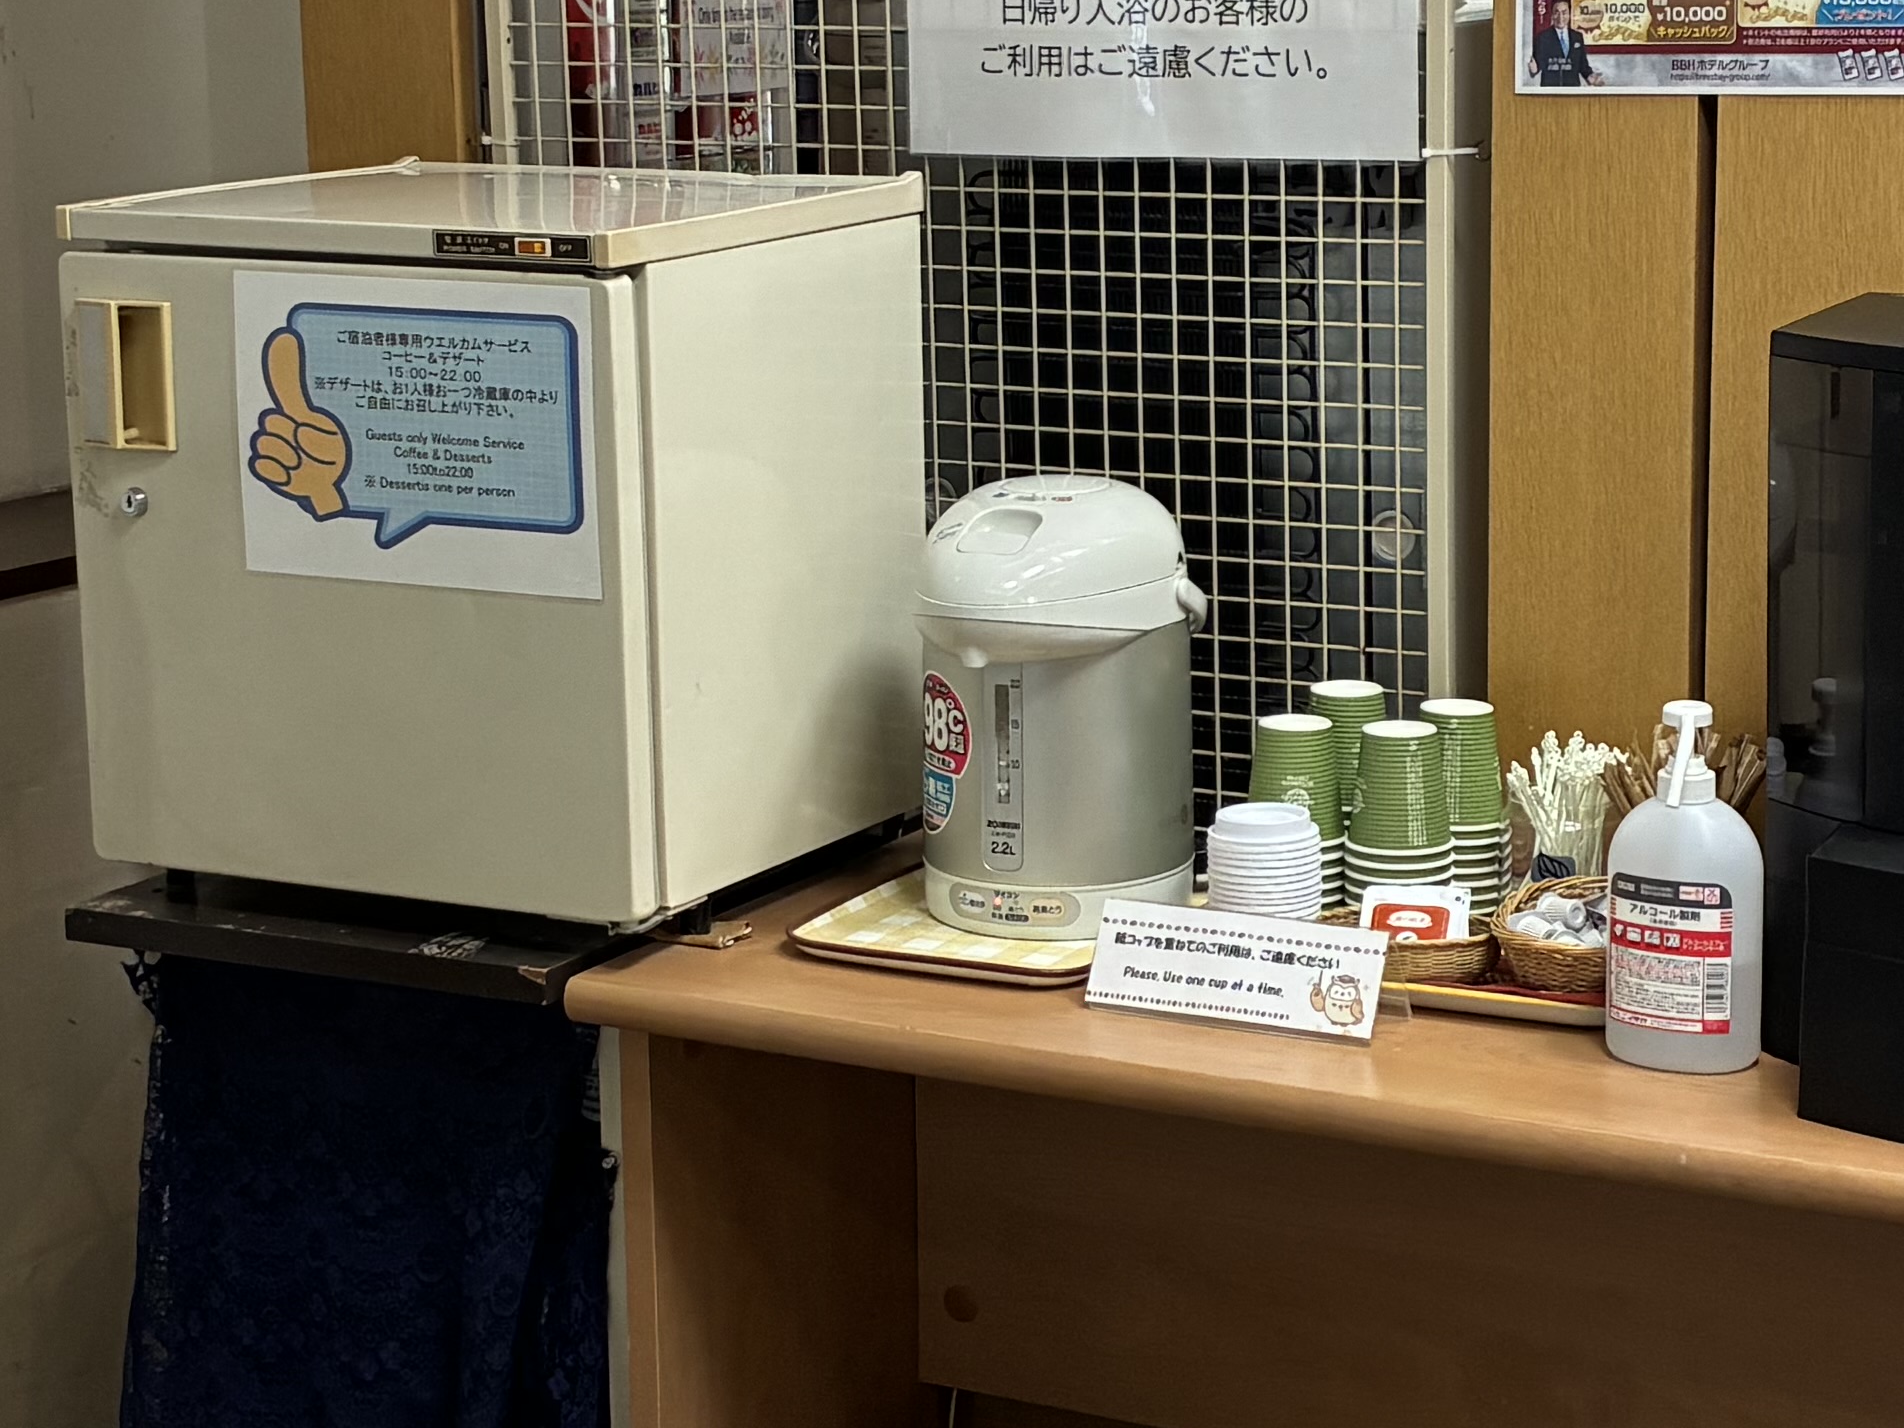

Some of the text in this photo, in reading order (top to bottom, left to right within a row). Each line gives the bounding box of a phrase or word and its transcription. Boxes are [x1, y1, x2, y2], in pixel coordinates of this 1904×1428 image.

[1604, 3, 1645, 14] 10,000
[1657, 26, 1728, 38] キャッシュバック
[981, 44, 1329, 80] ご利用はご遠慮ください。
[366, 428, 525, 450] Guests only Welcome Service
[394, 446, 428, 460] Coffee
[446, 450, 492, 464] Desserts
[433, 483, 453, 493] one
[457, 485, 473, 495] per
[478, 485, 515, 498] person
[1163, 971, 1184, 984] Use
[1186, 976, 1205, 987] one
[1209, 978, 1228, 990] cup
[1231, 979, 1243, 991] at
[1246, 984, 1254, 992] a
